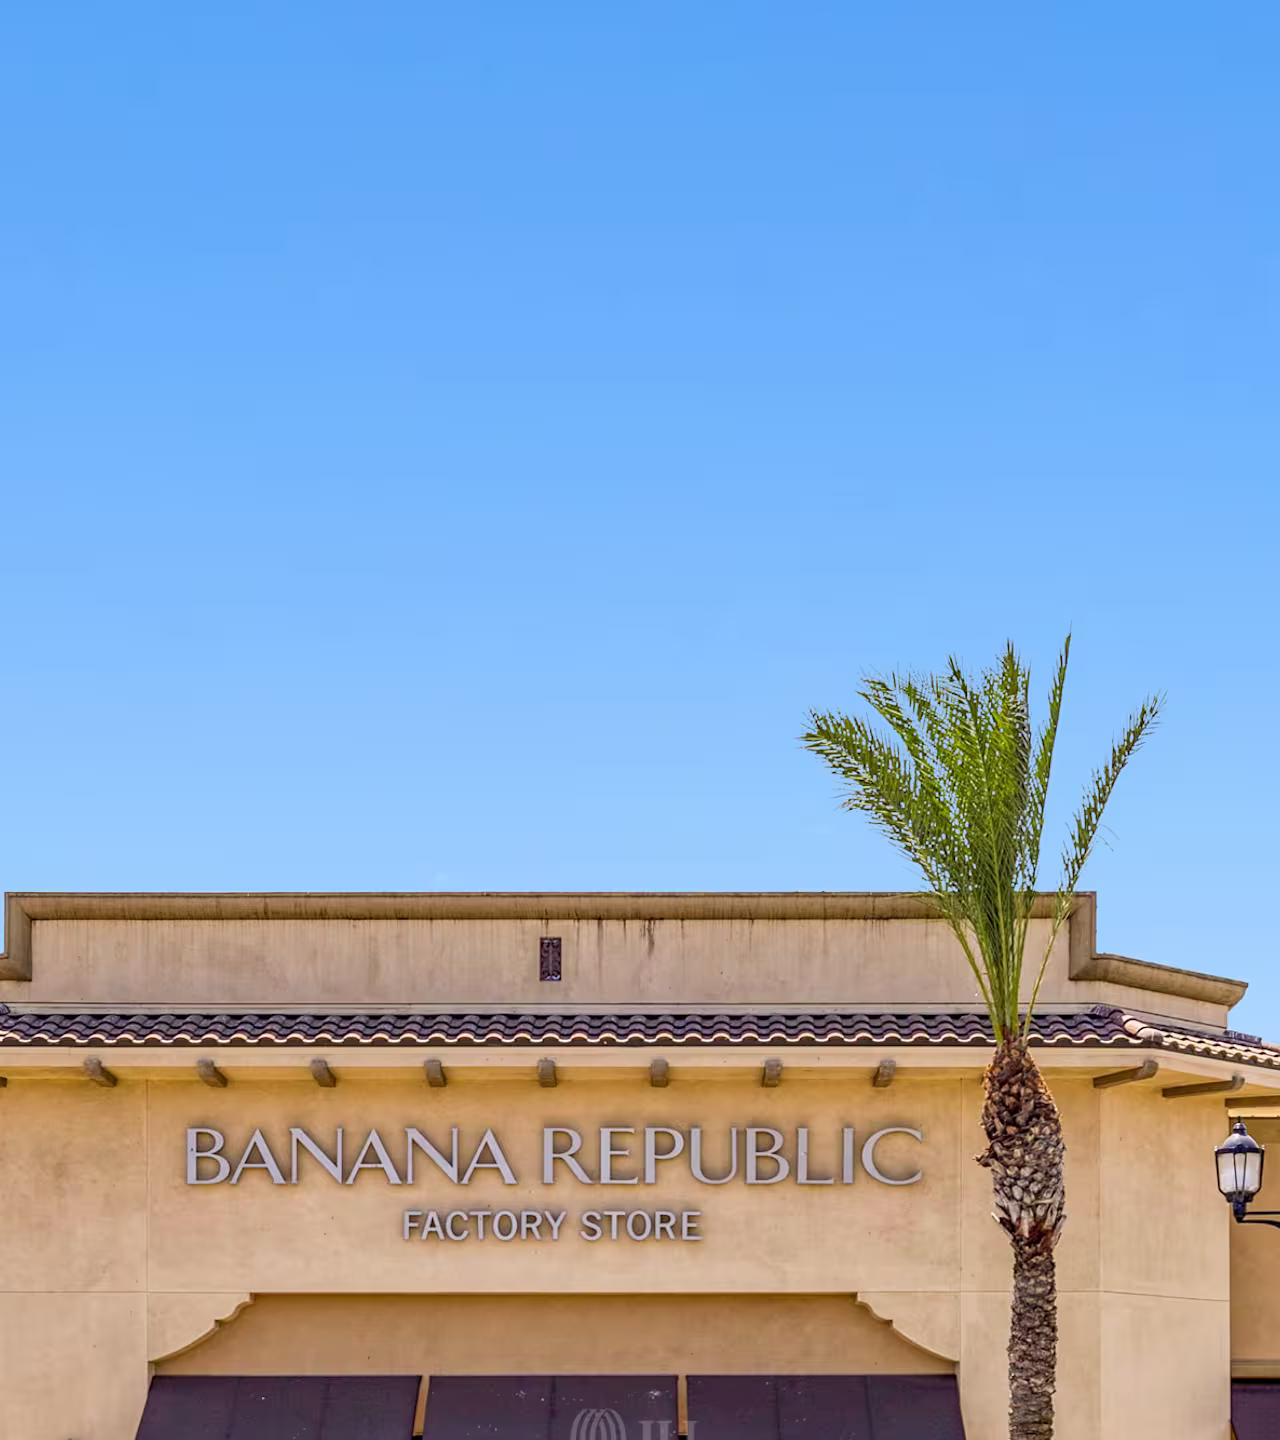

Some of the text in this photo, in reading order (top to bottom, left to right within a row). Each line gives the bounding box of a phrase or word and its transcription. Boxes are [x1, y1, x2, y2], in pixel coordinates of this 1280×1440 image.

[185, 1127, 923, 1186] BANANA REPUBLIC
[402, 1210, 703, 1241] FACTORY STORE
